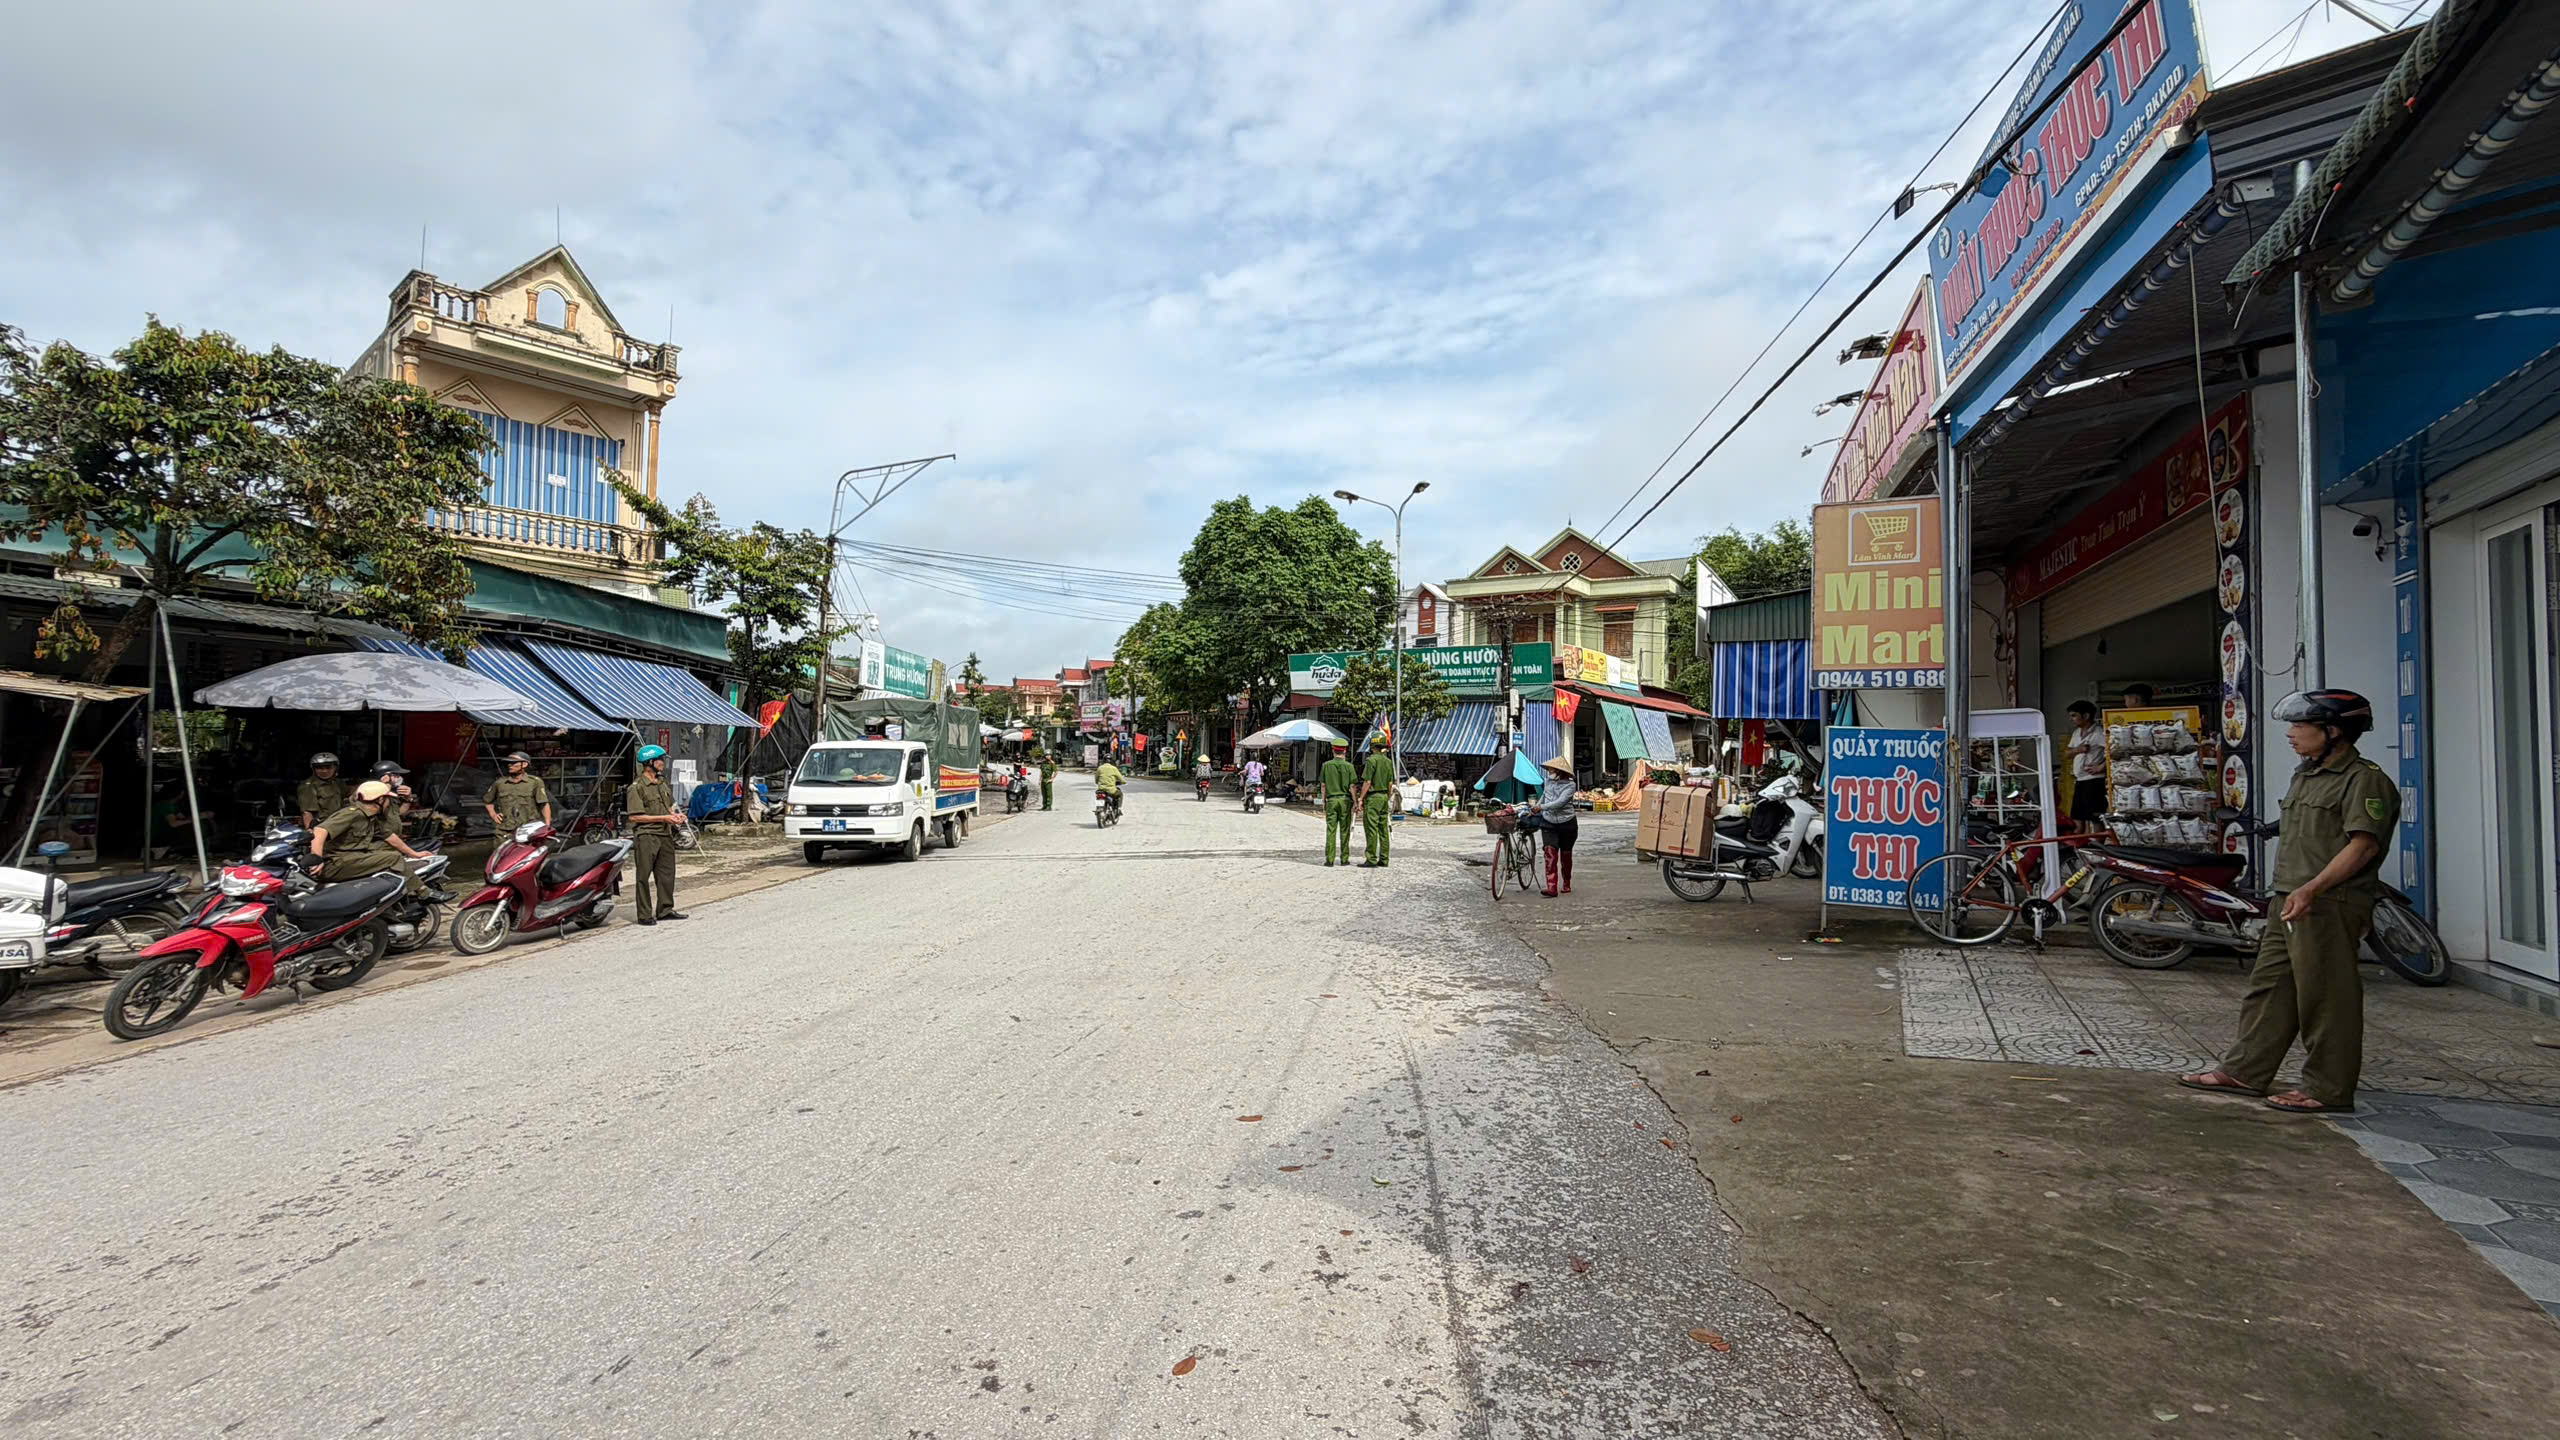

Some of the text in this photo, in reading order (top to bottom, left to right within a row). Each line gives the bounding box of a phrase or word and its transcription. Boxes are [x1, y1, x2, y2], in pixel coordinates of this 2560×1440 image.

[2075, 173, 2102, 207] GPKD:
[1824, 568, 1942, 612] Mini
[1422, 647, 1508, 666] HÙNG HƯỜN
[1822, 623, 1945, 665] Mart
[885, 663, 906, 683] TRUNG
[1448, 668, 1473, 678] DOANH
[1523, 664, 1543, 675] TOÀN
[1818, 671, 1866, 688] 0944
[1871, 671, 1908, 687] 519
[1832, 730, 1943, 759] QUẦY THUỐC
[1832, 765, 1941, 827] THỨC
[1829, 886, 1848, 902] ĐT:
[1851, 888, 1883, 904] 0383
[1914, 892, 1940, 908] 414
